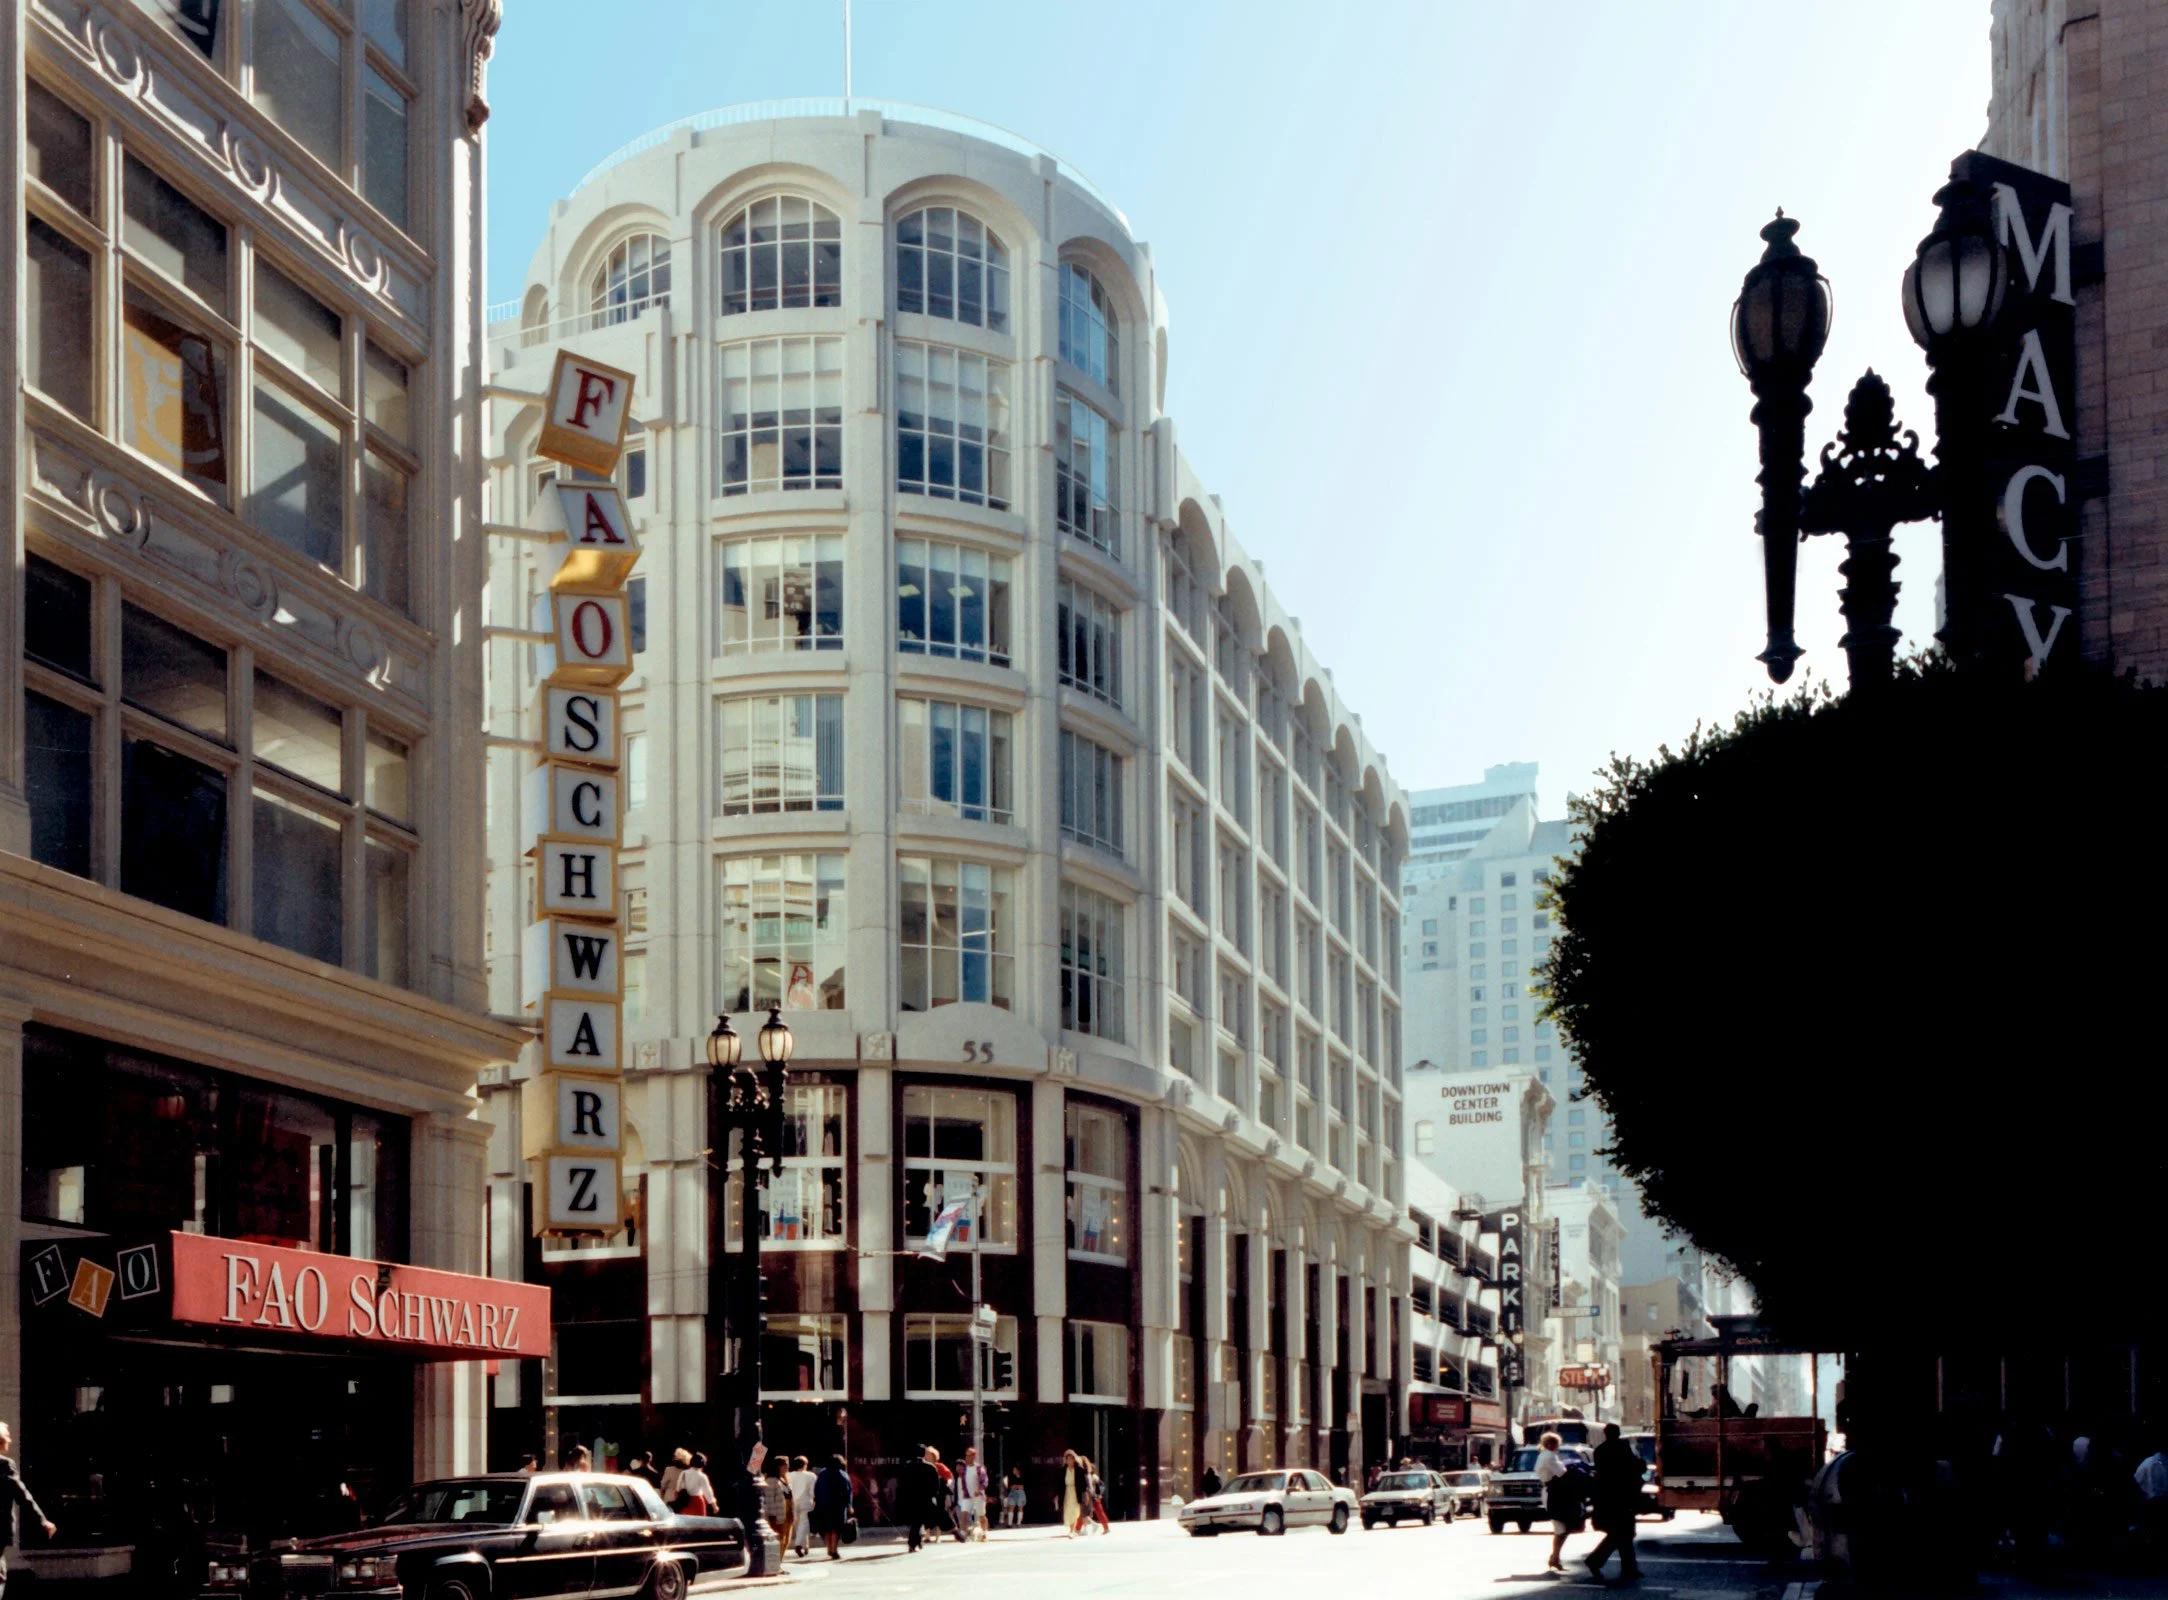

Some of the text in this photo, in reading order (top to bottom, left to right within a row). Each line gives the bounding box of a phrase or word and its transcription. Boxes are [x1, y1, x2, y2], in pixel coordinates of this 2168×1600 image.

[560, 695, 609, 1212] SCHWARZ
[963, 1040, 994, 1064] 55
[1441, 1082, 1510, 1098] DOWNTOWN
[1453, 1097, 1498, 1111] CENTER
[1449, 1111, 1503, 1125] BUILDING
